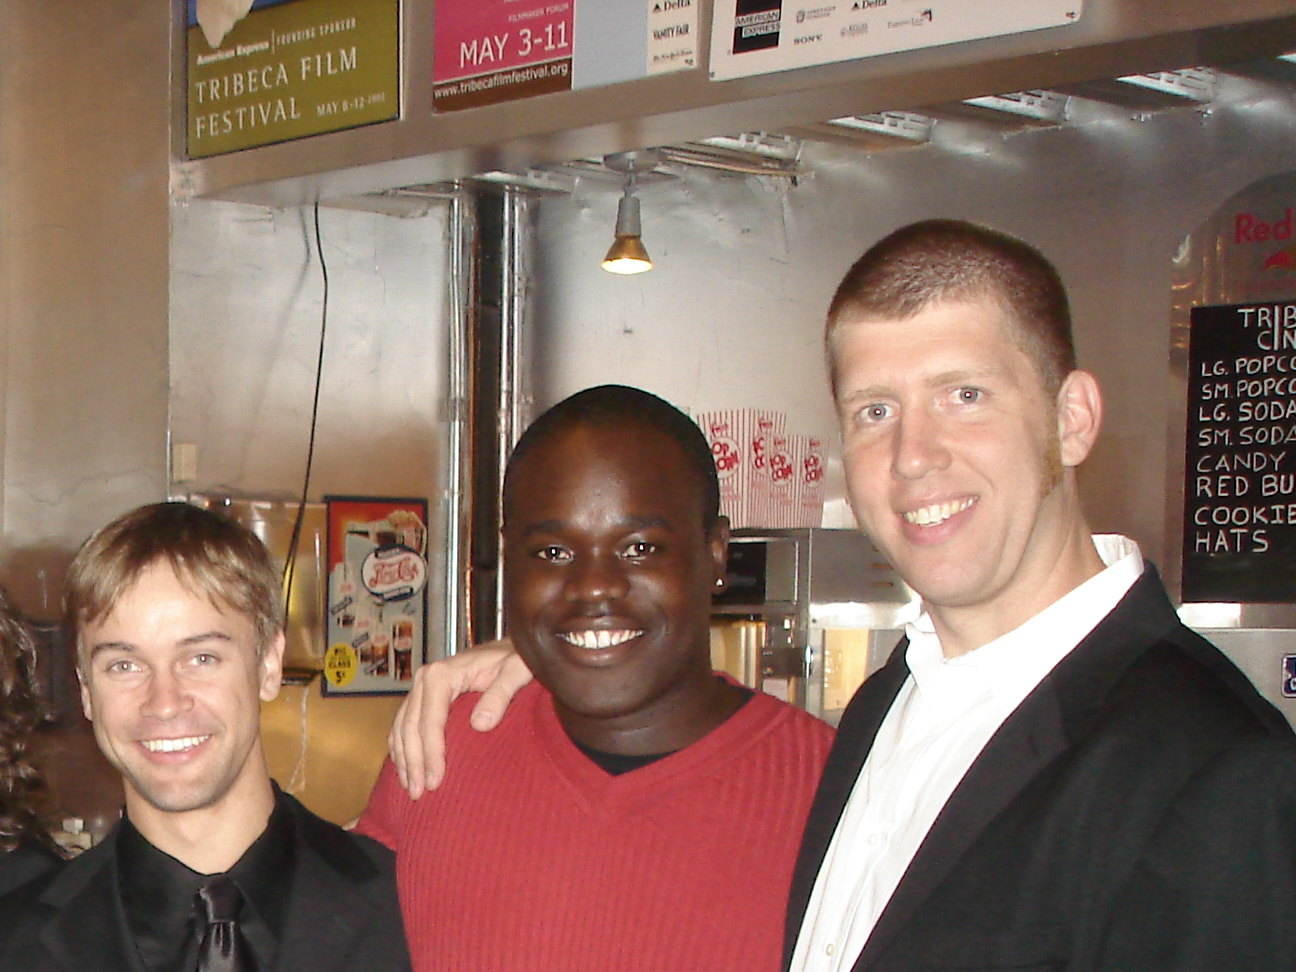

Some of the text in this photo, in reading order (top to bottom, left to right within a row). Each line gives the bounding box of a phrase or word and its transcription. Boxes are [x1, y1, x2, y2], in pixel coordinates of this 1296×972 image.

[736, 10, 779, 26] AMERICAN
[744, 21, 781, 36] EXPRESS
[652, 23, 690, 41] VANITY FAIR
[793, 33, 823, 46] SONY
[197, 49, 235, 66] American
[236, 40, 269, 58] Express
[459, 20, 569, 69] MAY 3-11
[195, 46, 357, 104] TRIBECA FILM
[434, 62, 569, 98] www.tribecafilmfestival.org
[195, 96, 301, 139] FESTIVAL
[316, 101, 339, 117] MAY
[1235, 208, 1294, 245] Red
[1237, 304, 1296, 329] TRIB
[1201, 361, 1229, 377] LG.
[1201, 383, 1234, 400] SM.
[1198, 399, 1296, 422] LG. SODA
[1198, 426, 1296, 447] SM. SODA
[711, 441, 730, 456] OP
[716, 450, 739, 472] ORN
[1197, 451, 1286, 472] CANDY
[1196, 474, 1294, 498] RED BU
[1194, 504, 1296, 525] COOKIE
[1195, 529, 1269, 552] HATS
